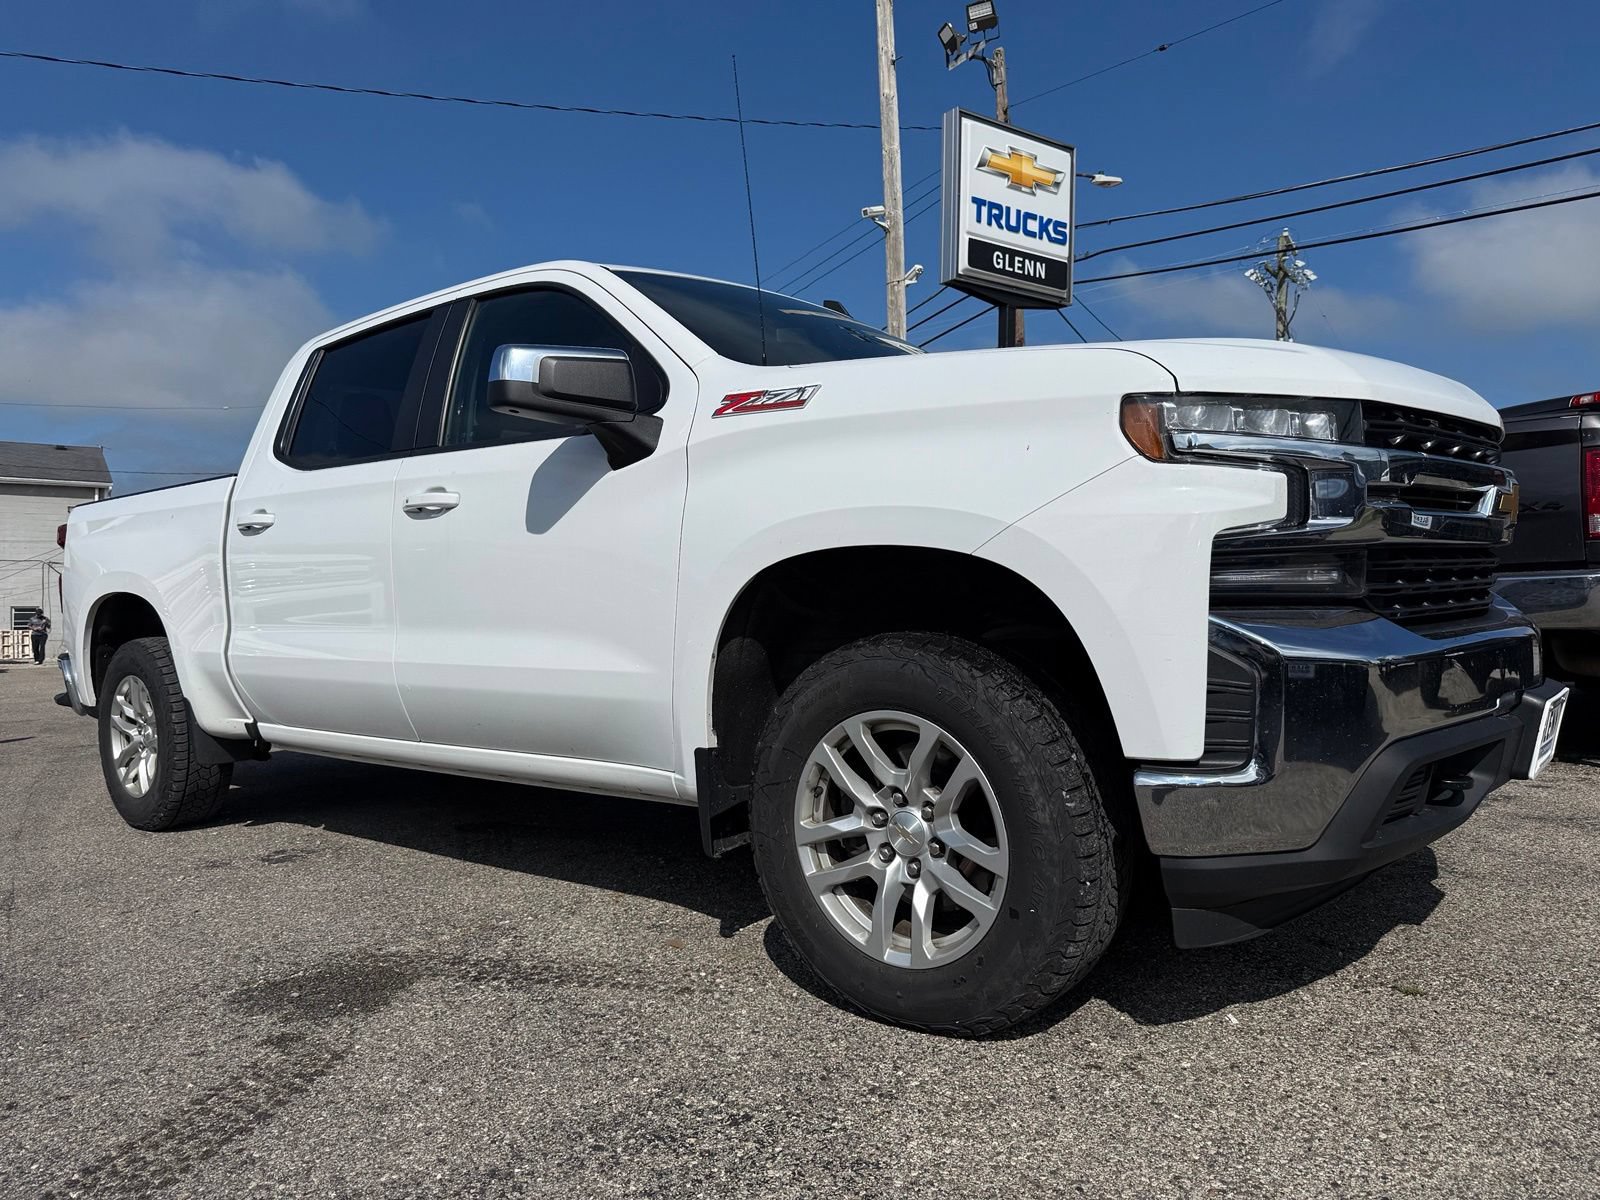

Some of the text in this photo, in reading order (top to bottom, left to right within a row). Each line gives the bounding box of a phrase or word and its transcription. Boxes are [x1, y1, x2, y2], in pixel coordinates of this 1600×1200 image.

[971, 196, 1068, 246] TRUCKS
[993, 251, 1046, 280] GLENN
[711, 384, 822, 419] Z71
